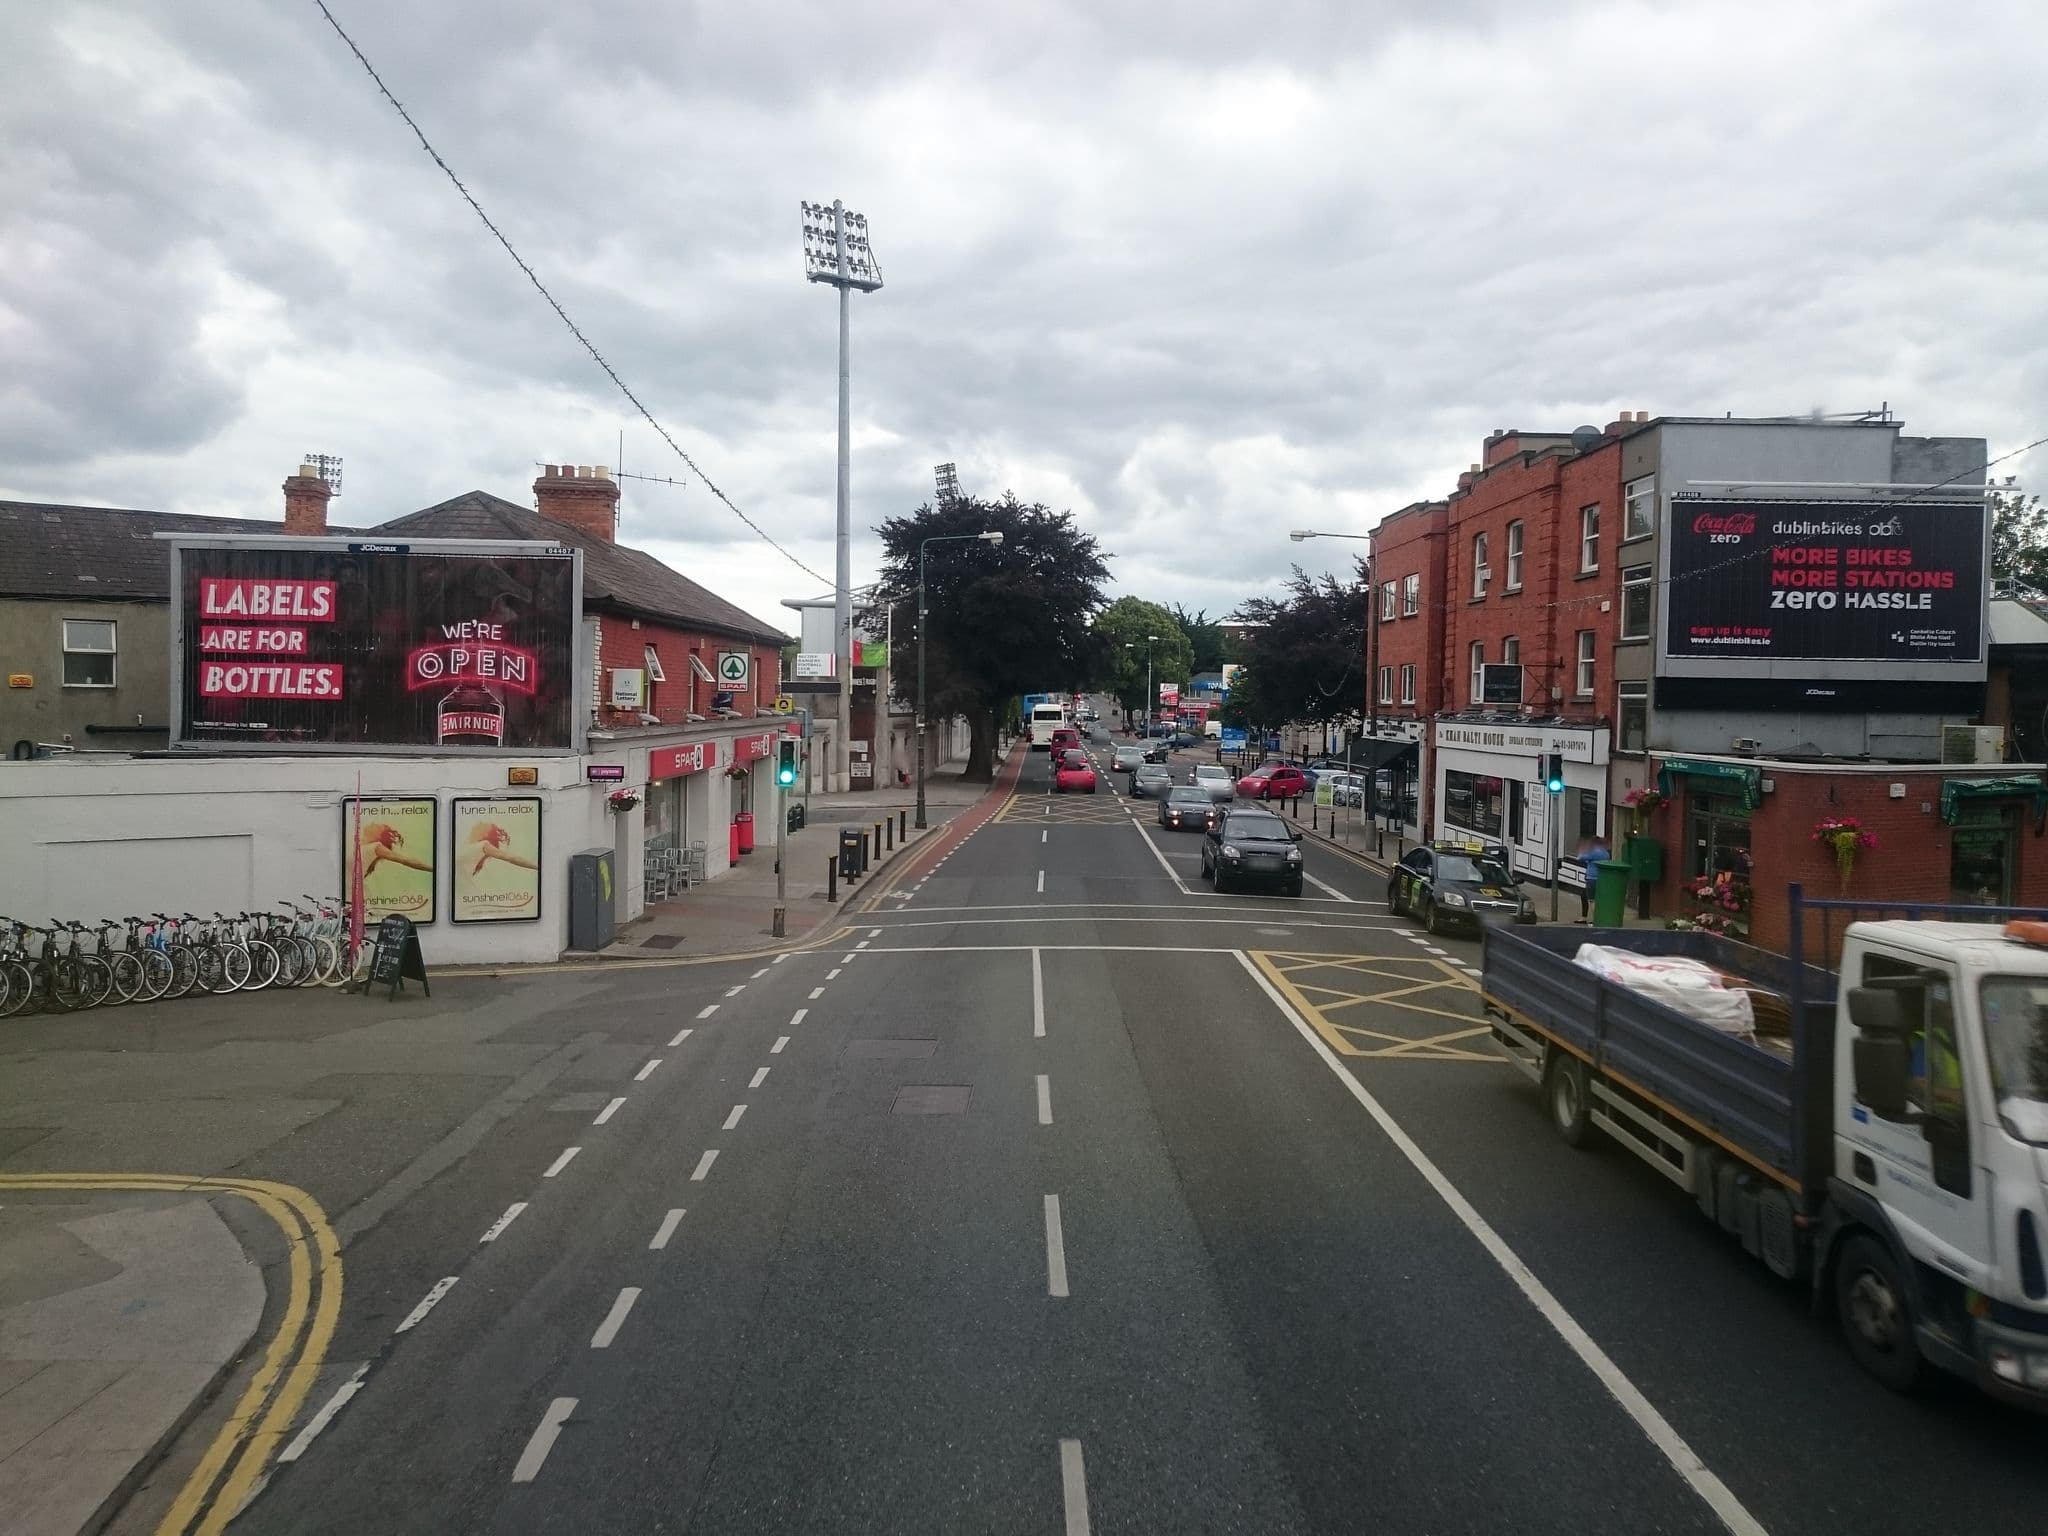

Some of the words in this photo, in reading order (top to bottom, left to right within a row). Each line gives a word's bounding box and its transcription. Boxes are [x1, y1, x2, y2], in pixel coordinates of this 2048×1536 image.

[1693, 512, 1757, 534] Coca-Cola
[1772, 520, 1863, 536] dublinbikes
[1709, 533, 1741, 544] zero
[360, 544, 397, 552] JCDecaux
[1771, 548, 1839, 565] MORE
[1845, 549, 1913, 566] BIKES
[1771, 570, 1838, 588] MORE
[1845, 570, 1954, 589] STATIONS
[206, 584, 332, 617] LABELS
[1769, 590, 1838, 610] zero
[1845, 592, 1932, 610] HASSLE
[441, 619, 503, 641] WE'RE
[1745, 627, 1771, 639] easy
[204, 629, 253, 650] ARE
[255, 630, 304, 651] FOR
[1690, 636, 1771, 646] www.dublinbikes.ie
[417, 648, 525, 682] OPEN
[205, 666, 340, 696] BOTTLES.
[720, 682, 746, 690] SPAR
[1463, 730, 1480, 744] BALTI
[1483, 732, 1504, 746] HOUSE
[751, 740, 763, 753] SPAR
[675, 751, 695, 768] SPAR
[401, 804, 429, 815] relax
[460, 805, 487, 815] tune
[508, 804, 534, 814] relax
